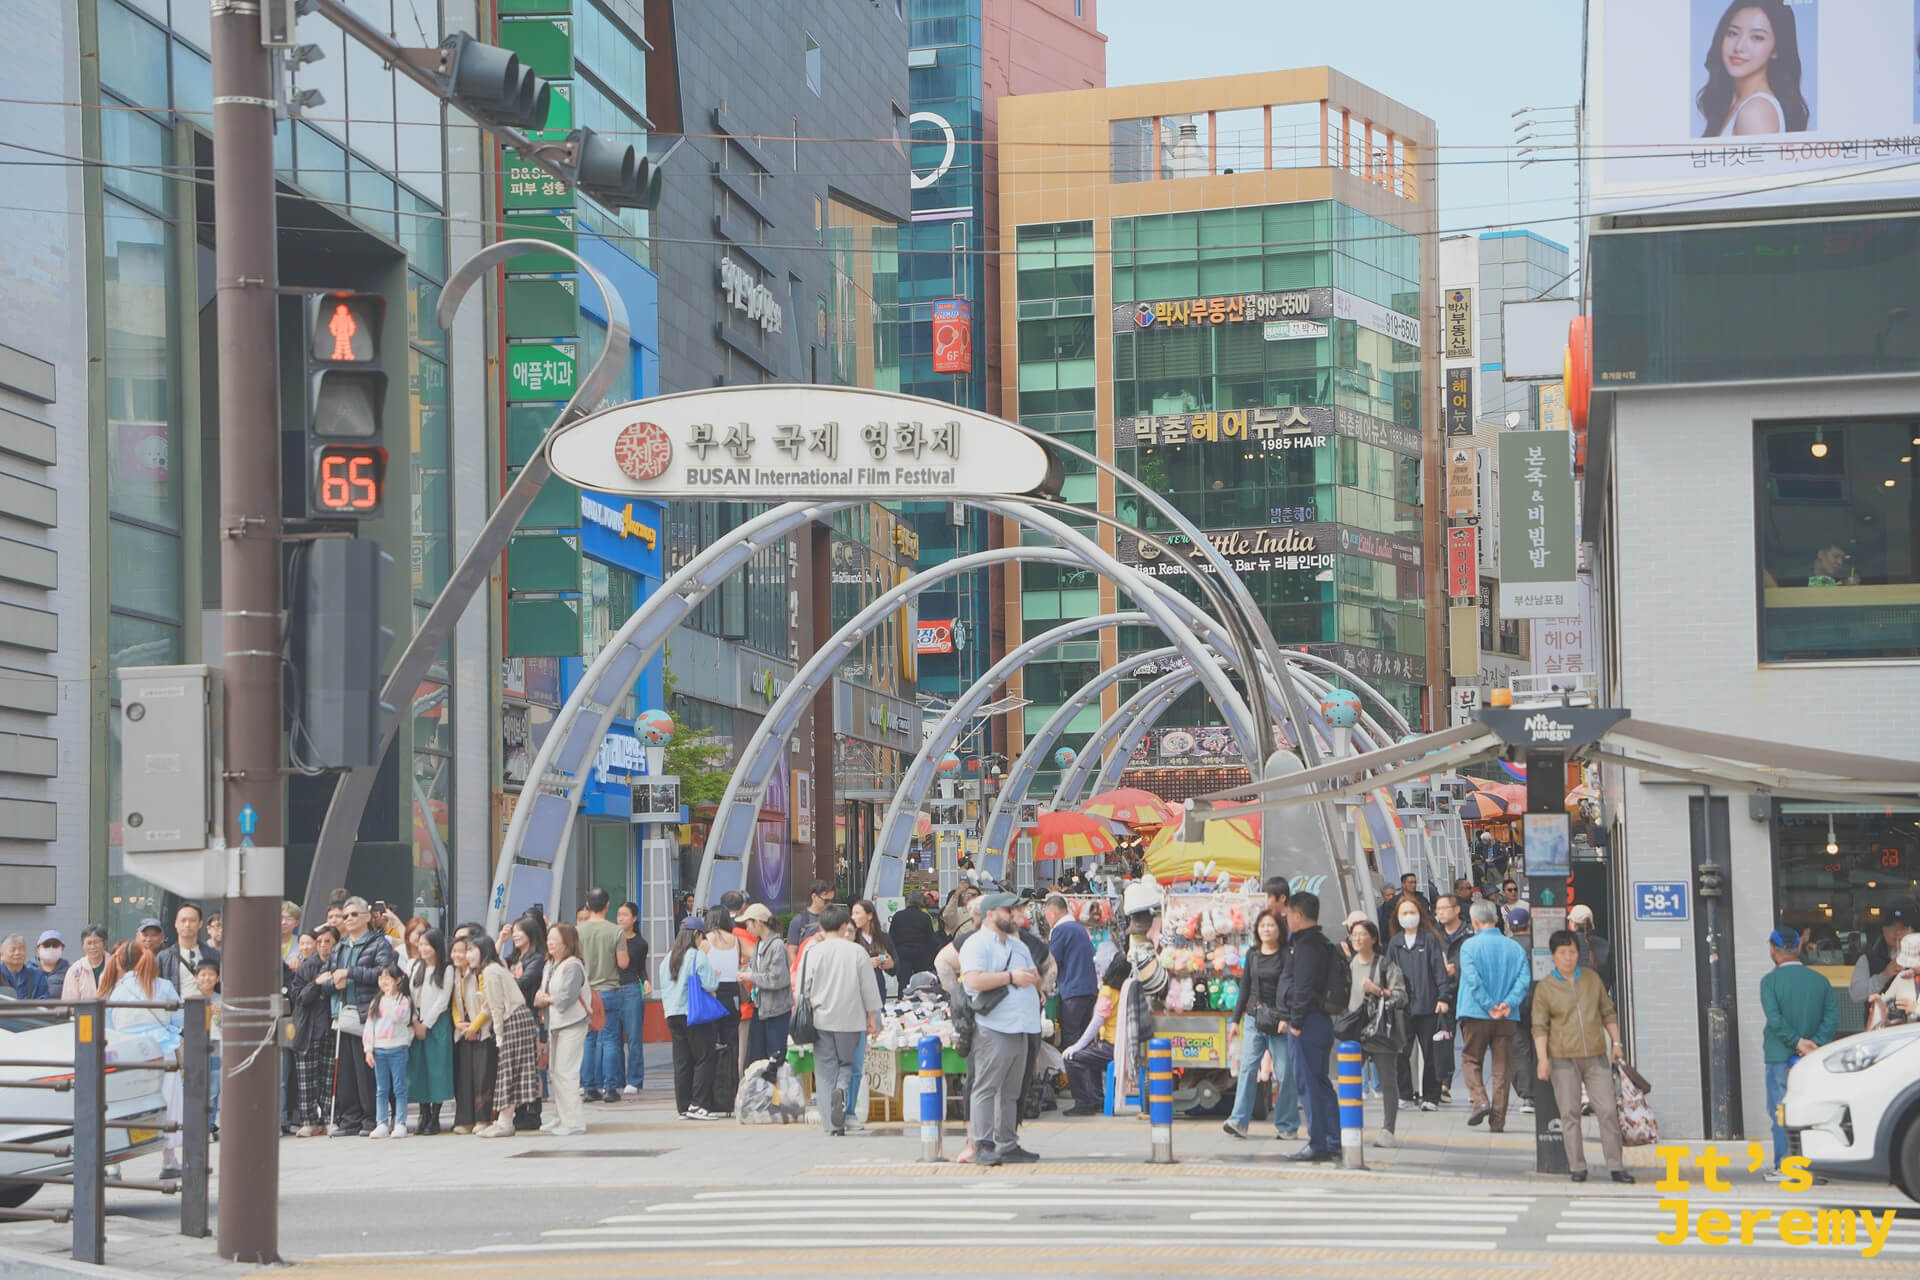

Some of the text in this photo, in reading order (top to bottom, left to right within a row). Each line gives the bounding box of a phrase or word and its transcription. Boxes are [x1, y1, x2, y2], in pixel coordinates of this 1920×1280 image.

[510, 182, 537, 196] 피부
[1155, 296, 1245, 325] 박사부동산
[1257, 294, 1310, 317] 919-5500
[1385, 312, 1419, 343] 919-5500
[1451, 313, 1466, 348] 부동산
[513, 360, 573, 390] 애플치과
[686, 421, 961, 460] 부산 국제 영화제
[1261, 435, 1326, 450] 1985 HAIR
[322, 456, 376, 507] 65
[686, 465, 955, 486] BUSAN International Film Festival
[1252, 528, 1317, 554] India
[1235, 559, 1257, 571] Bar
[1258, 557, 1271, 571] 뉴
[1545, 631, 1583, 650] 헤어
[1644, 893, 1679, 910] 58-1
